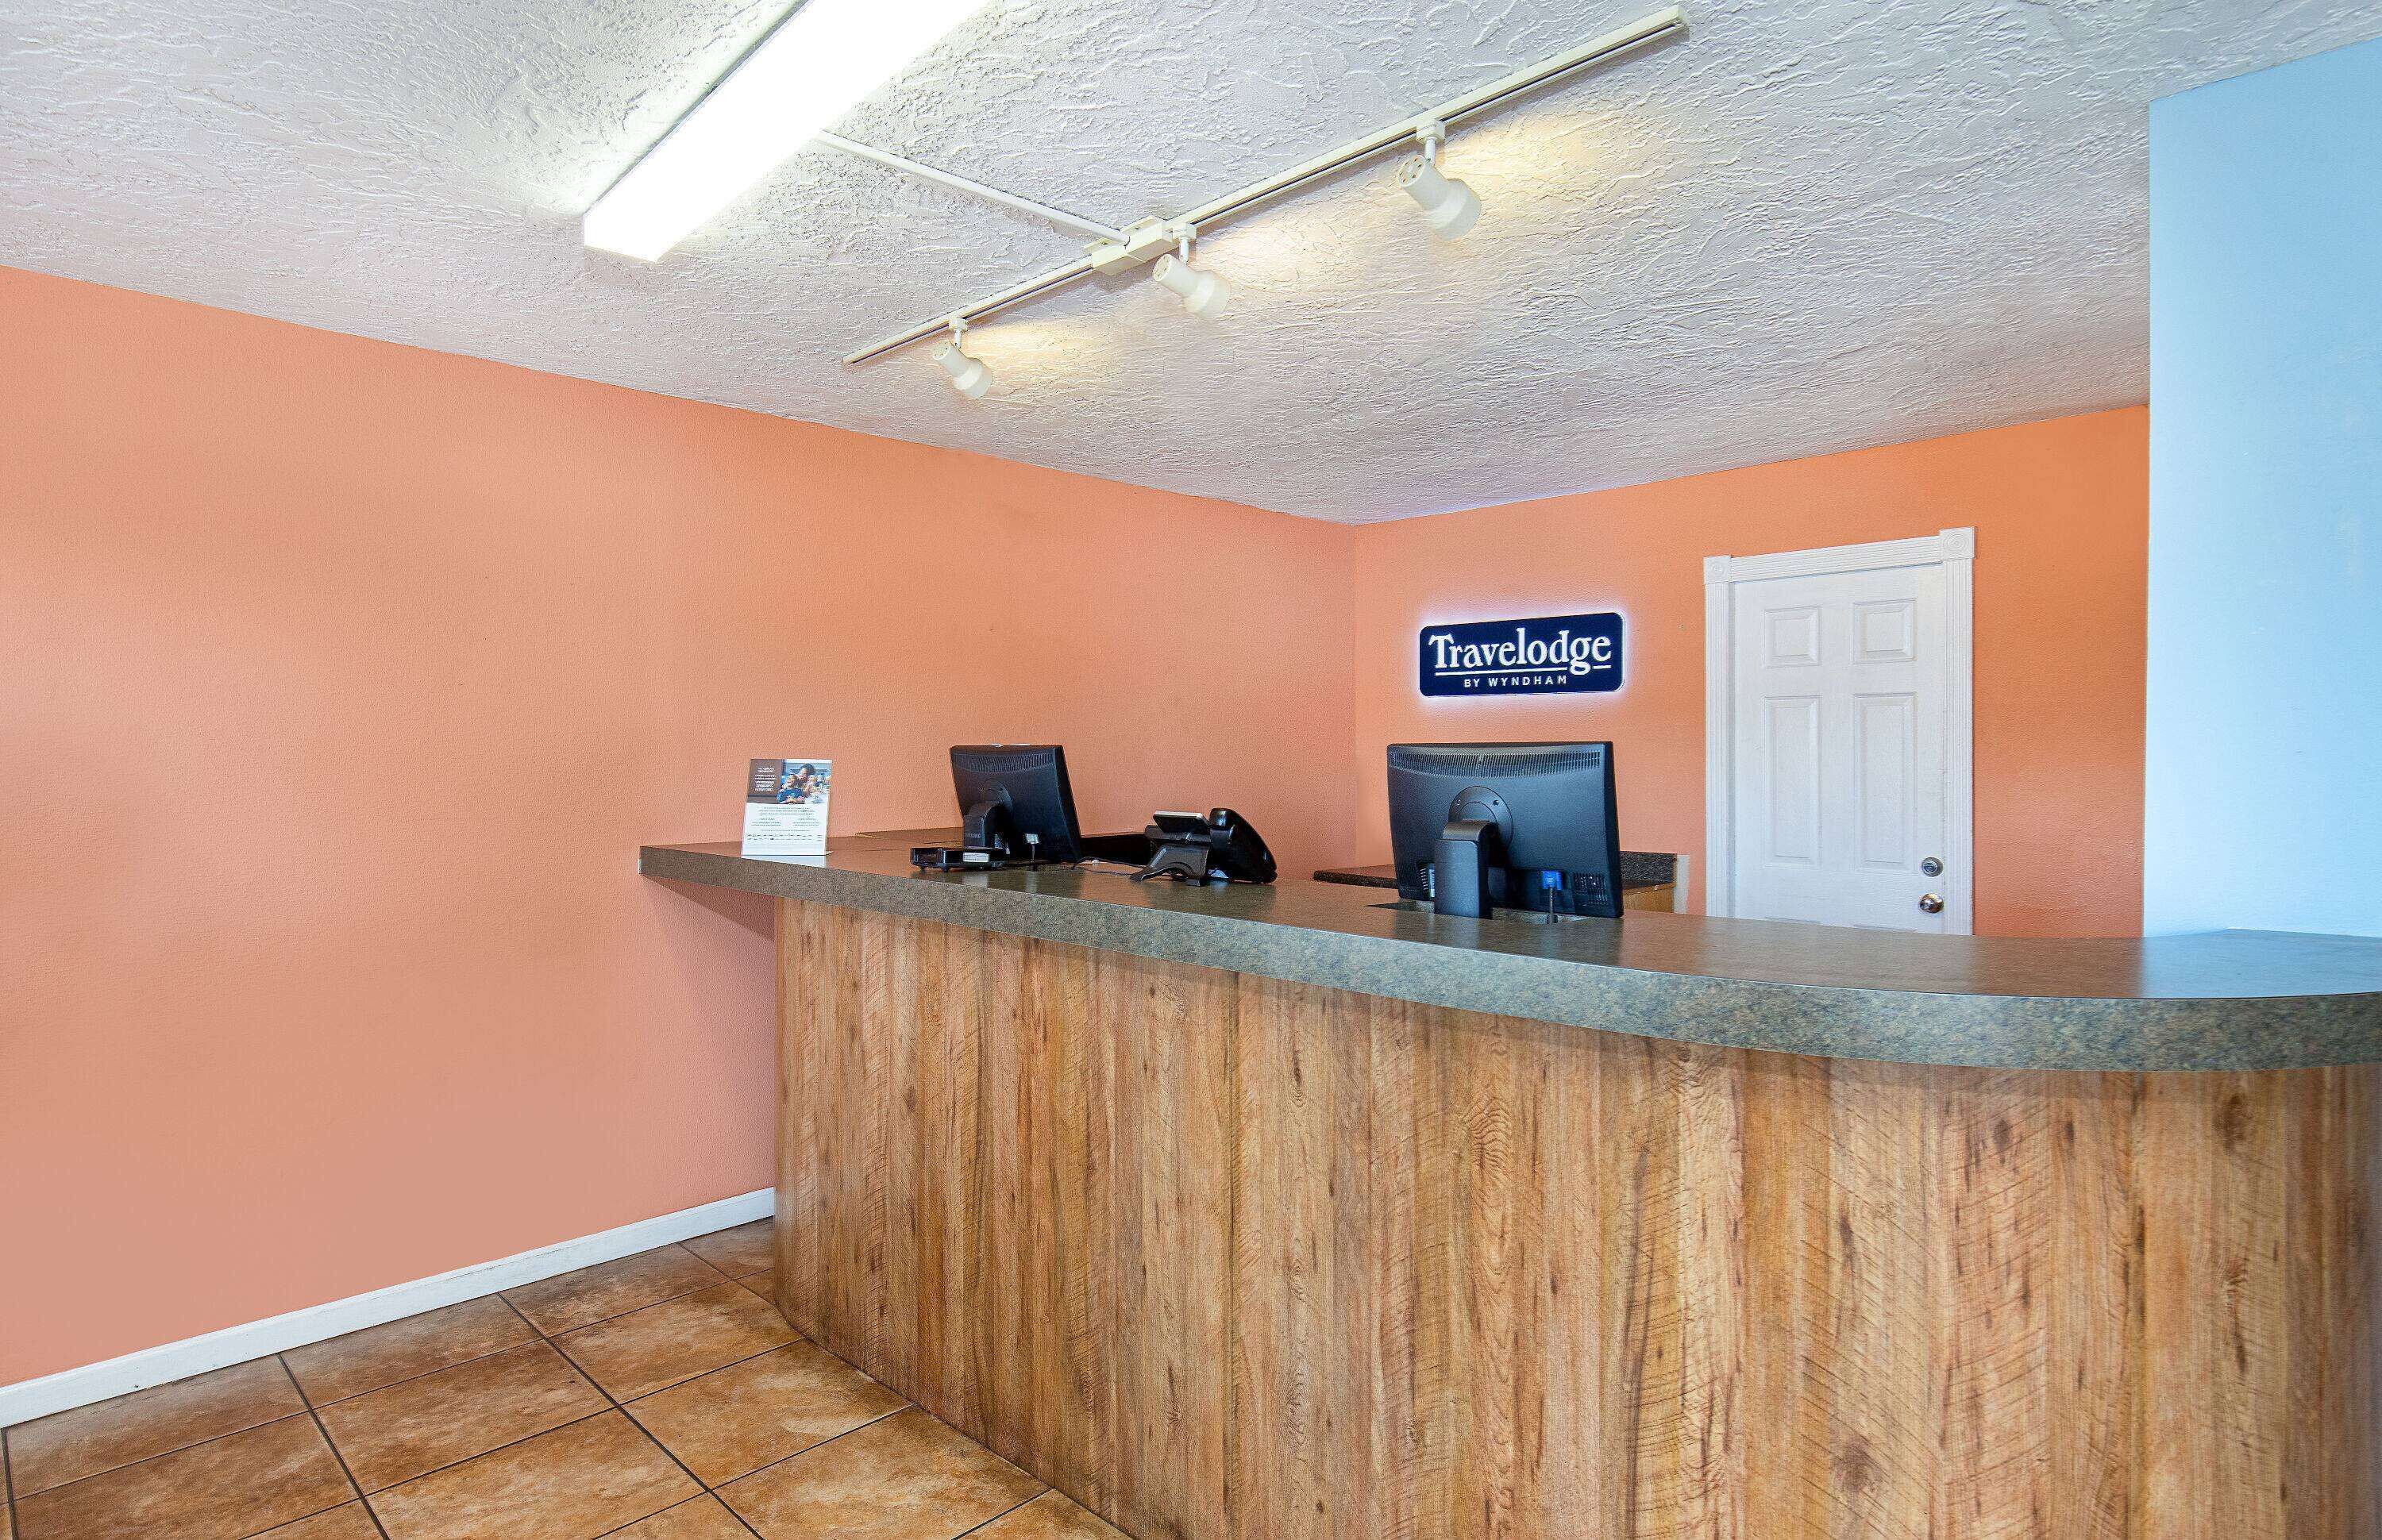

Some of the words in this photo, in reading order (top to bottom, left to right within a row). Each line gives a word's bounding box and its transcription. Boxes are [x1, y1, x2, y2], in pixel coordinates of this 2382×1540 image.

[1428, 628, 1611, 675] Travelodge
[1464, 678, 1480, 687] BY
[1488, 675, 1567, 687] WYNDHAM
